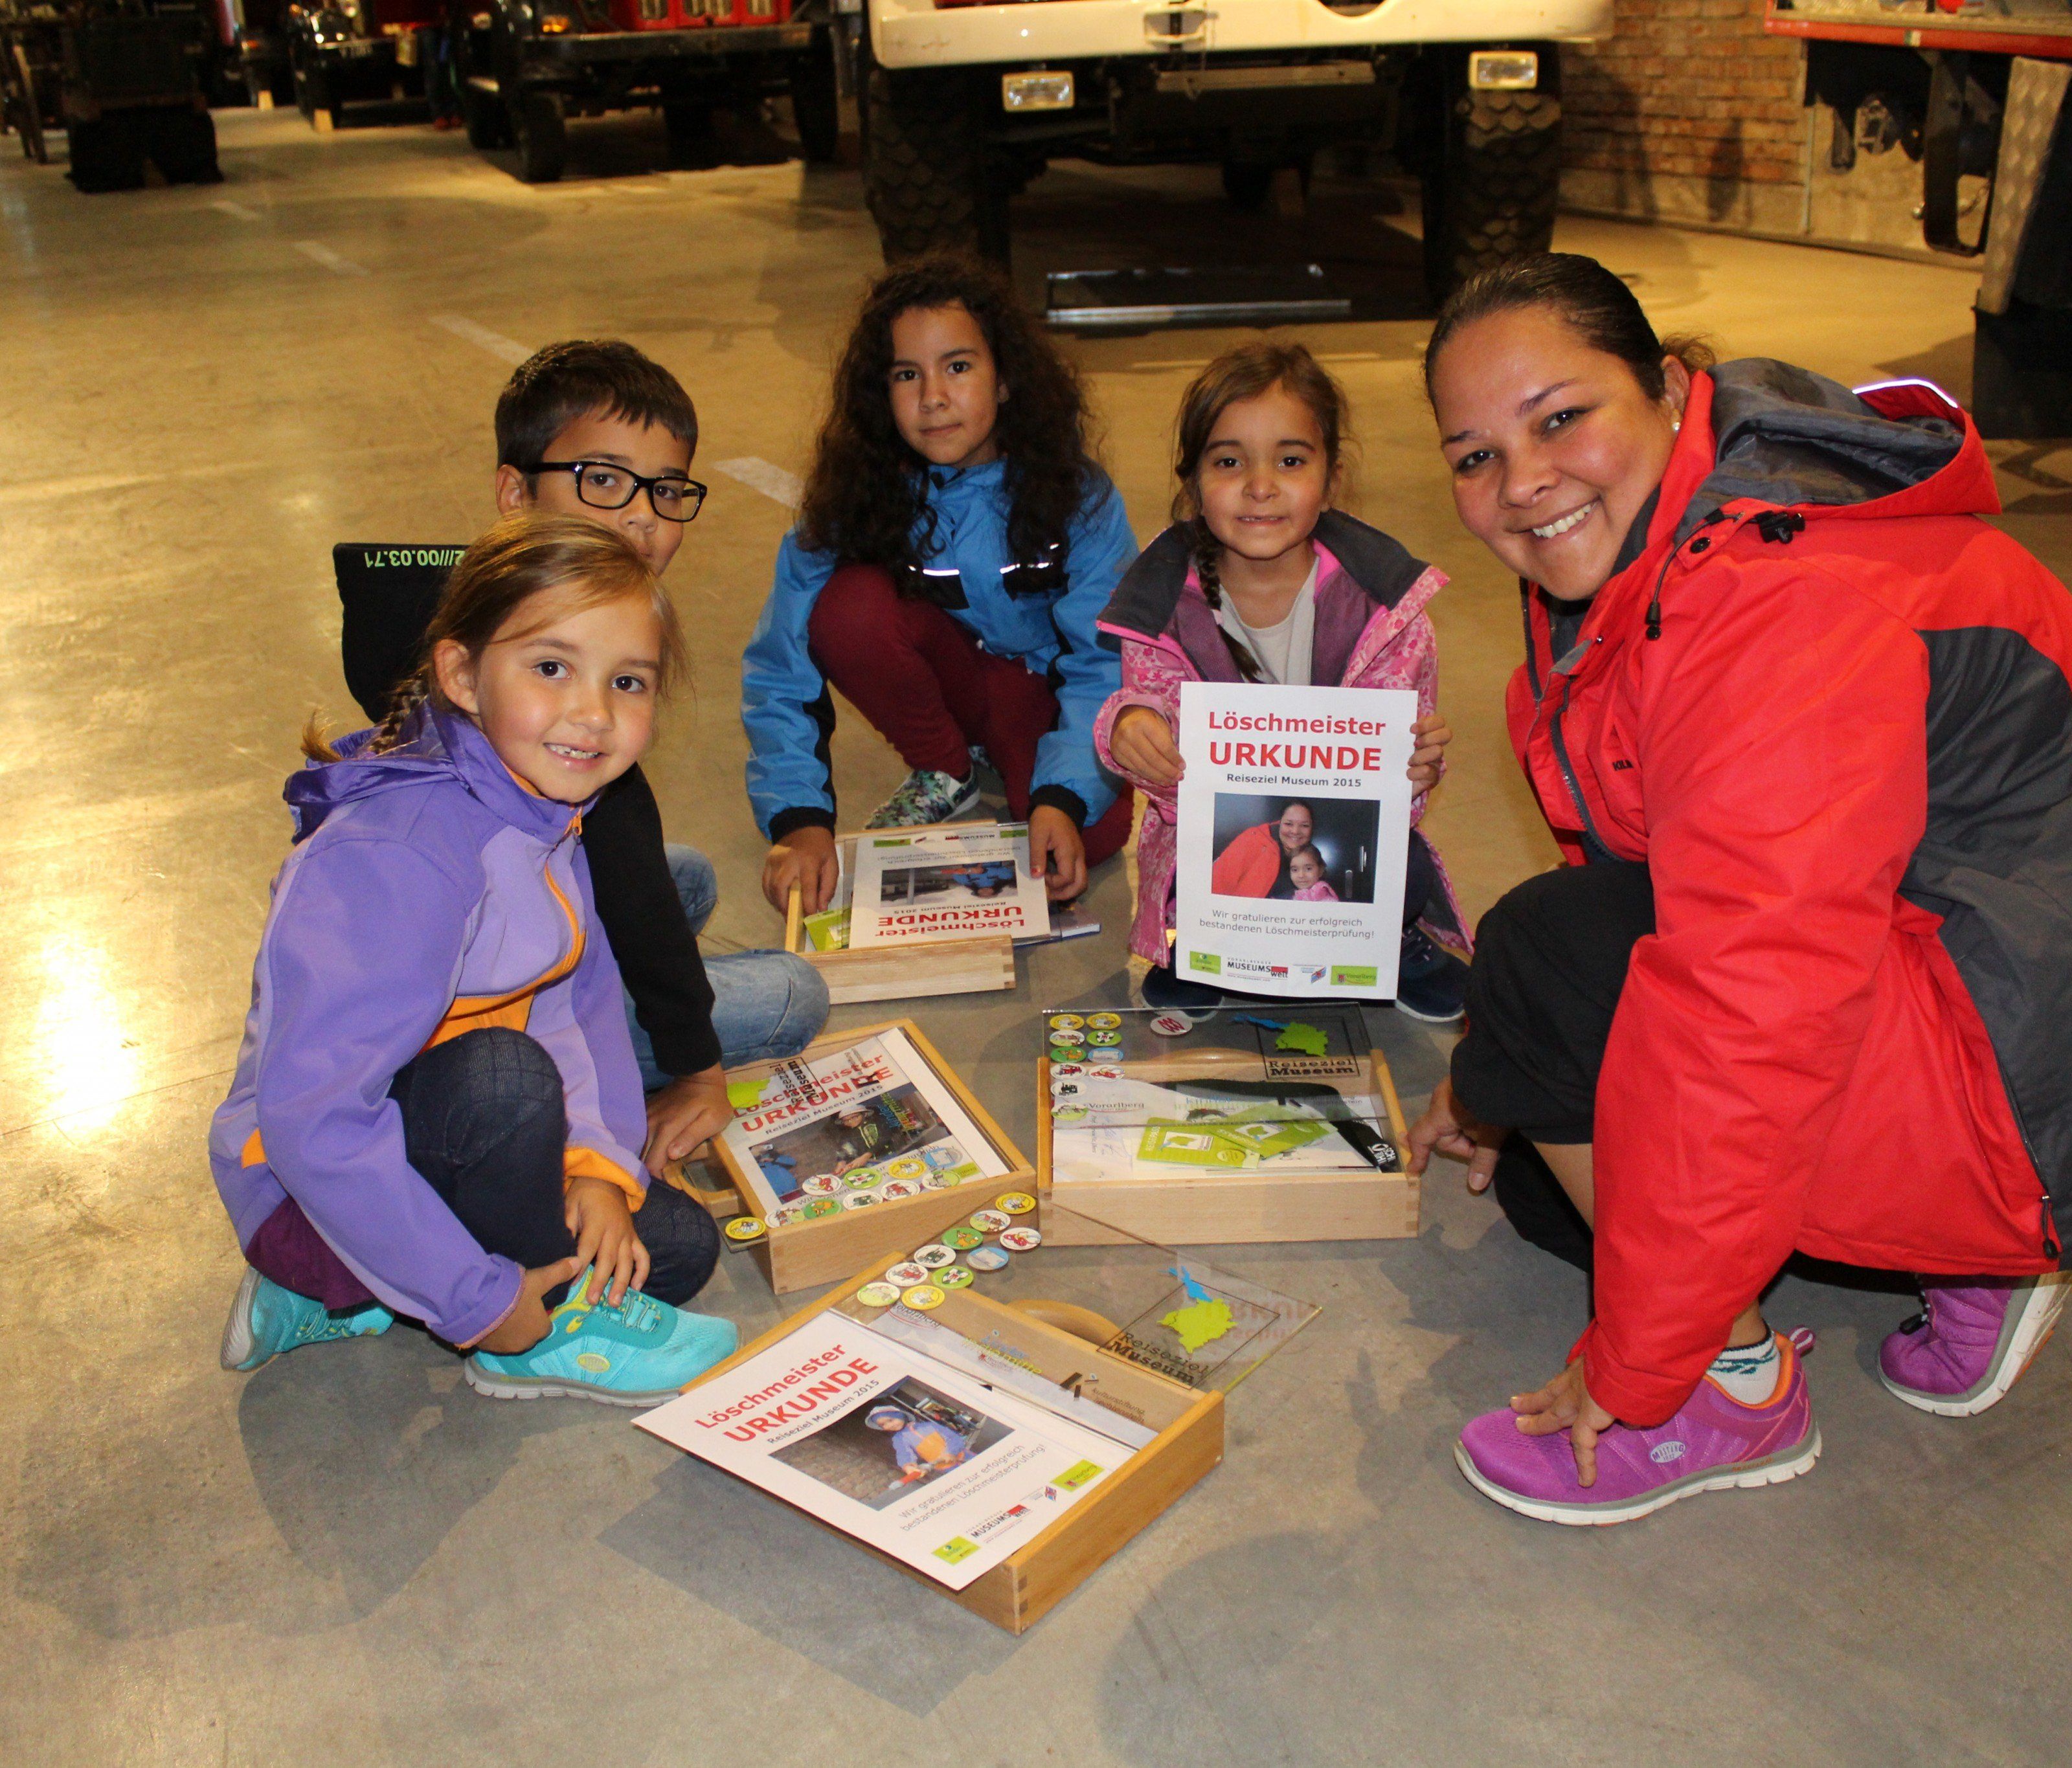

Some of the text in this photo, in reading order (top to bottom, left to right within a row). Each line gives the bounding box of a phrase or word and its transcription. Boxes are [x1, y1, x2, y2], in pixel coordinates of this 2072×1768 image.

[1208, 711, 1386, 735] Löschmeister
[1210, 741, 1382, 771] URKUNDE
[1226, 773, 1362, 787] Reiseziel Museum 2015
[875, 919, 1025, 937] Löschmeister
[877, 906, 1022, 926] URKUNDE
[1199, 918, 1375, 940] bestandenen Löschmeisterprüfung!
[1211, 909, 1230, 919] Wir
[1232, 912, 1287, 924] gratulieren
[1309, 917, 1363, 928] erfolgreich
[1227, 961, 1271, 972] MUSEUMS
[1269, 1058, 1355, 1068] Reiseziel
[1270, 1067, 1355, 1076] Museum
[765, 1084, 883, 1135] Reiseziel Museum 2015
[1108, 1341, 1195, 1384] Museum
[1118, 1332, 1210, 1374] Reiseziel
[694, 1343, 846, 1429] Löschmeister
[723, 1358, 879, 1442] URKUNDE
[767, 1380, 880, 1444] Reiseziel Museum 2015
[899, 1444, 1025, 1519] Wir gratulieren zur erfolgreich
[901, 1497, 960, 1532] bestandenen
[970, 1512, 1013, 1539] MUSEUMS
